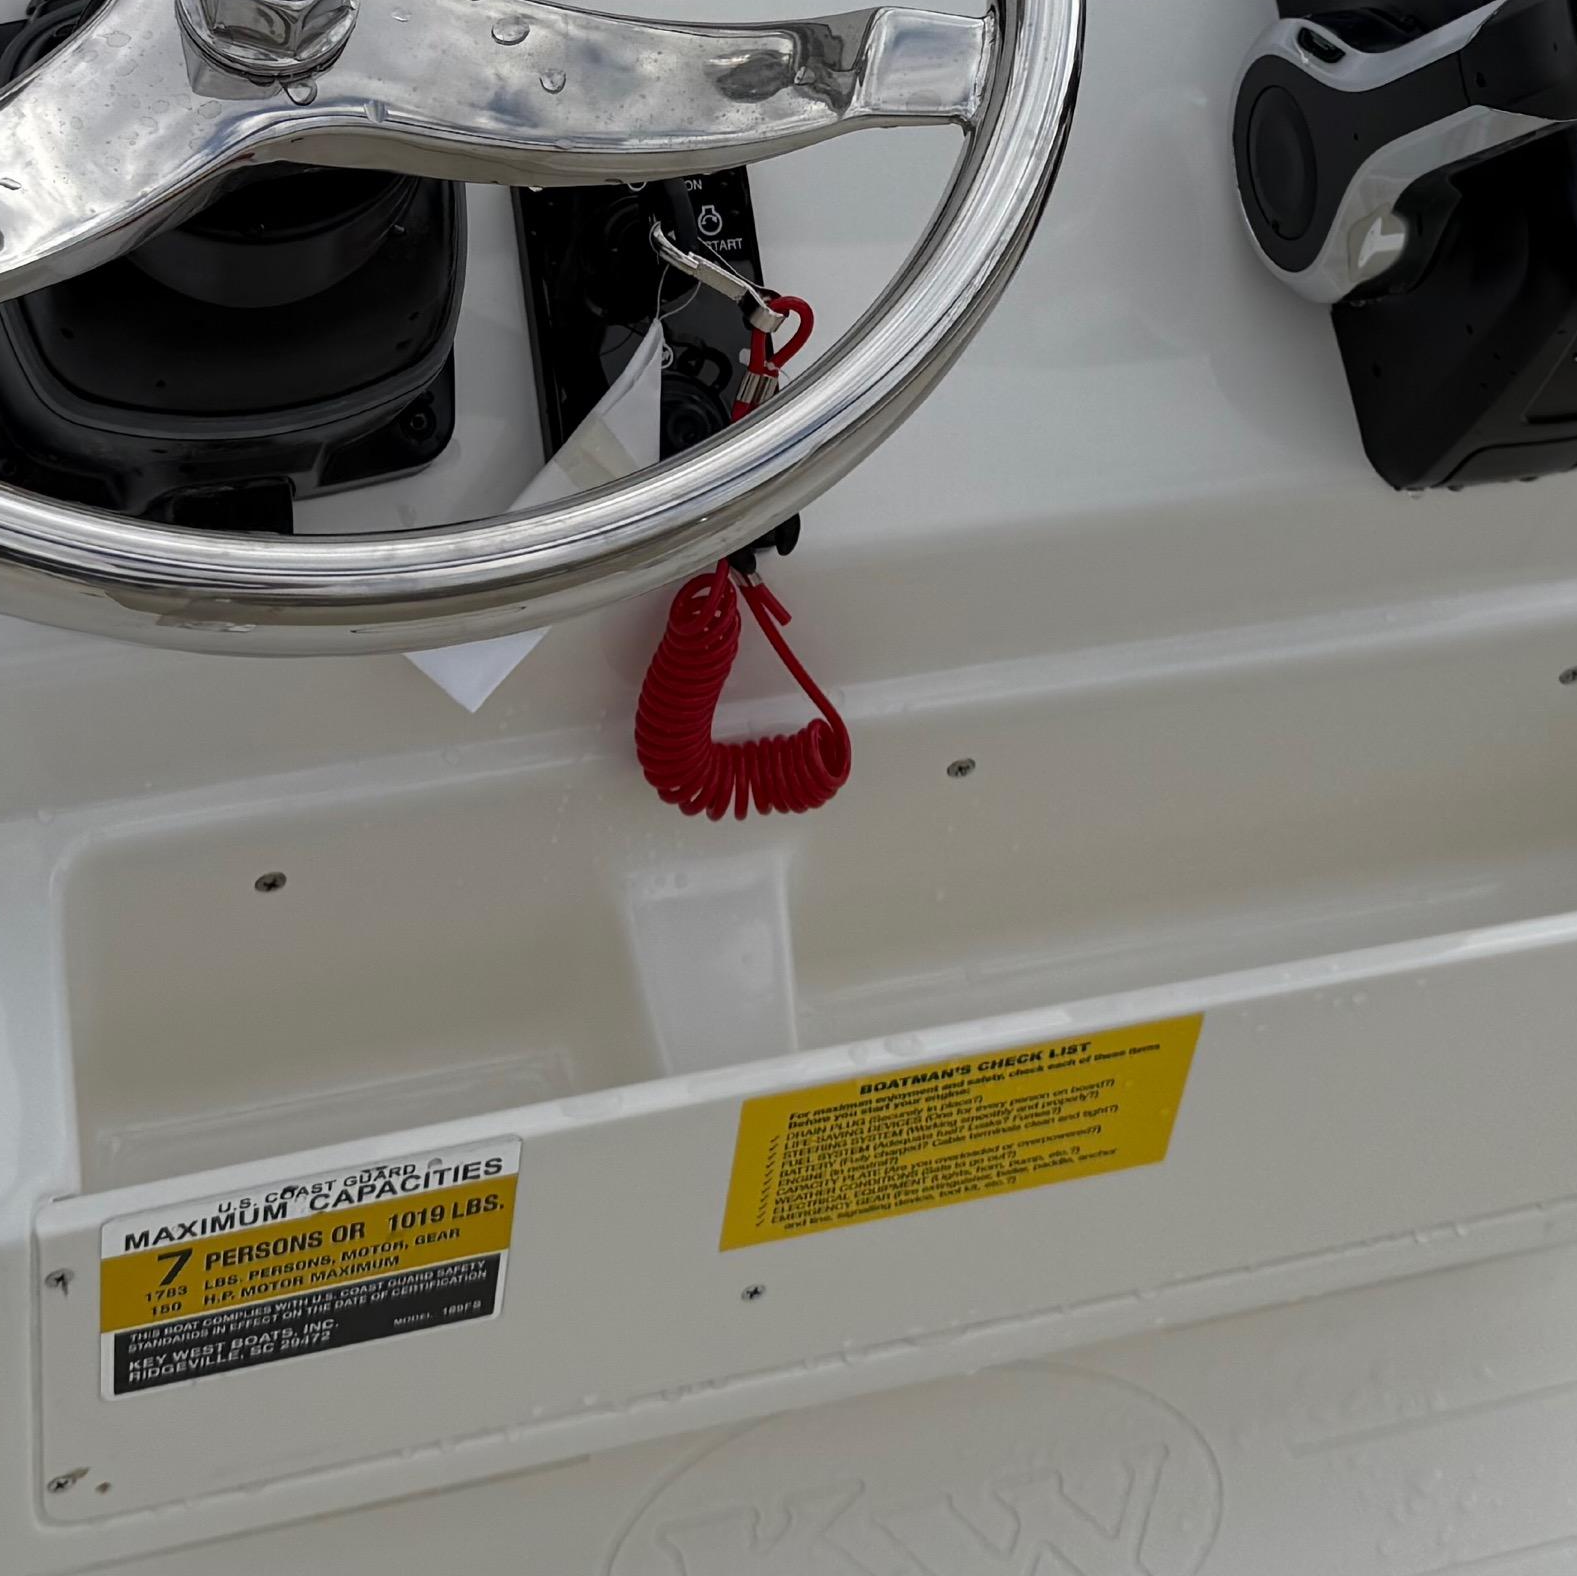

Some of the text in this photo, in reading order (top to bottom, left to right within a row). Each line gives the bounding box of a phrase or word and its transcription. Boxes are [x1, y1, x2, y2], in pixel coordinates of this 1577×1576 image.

[860, 1042, 1092, 1094] BOATMAN'S CHECK LIST
[124, 1156, 504, 1252] MAXIMUM CAPACITIES
[218, 1162, 416, 1214] U.S. COAST GUARD
[145, 1228, 460, 1303] 1783 LBS. PERSONS, MOTOR, GEAR
[157, 1191, 506, 1286] 7 PERSONS OR 1019 LBS.
[128, 1270, 486, 1353] STANDARDS IN EFFECT ON THE DATE OF CERTIFICATION
[130, 1329, 160, 1342] THIS
[164, 1321, 197, 1335] BOAT
[202, 1305, 271, 1327] COMPLIES
[275, 1297, 308, 1311] WITH
[340, 1281, 384, 1298] COAST
[388, 1271, 433, 1287] GUARD
[436, 1260, 485, 1277] SAFETY
[152, 1255, 399, 1316] 150 H.P. MOTOR MAXIMUM
[128, 1330, 331, 1383] RIDGEVILLE, SC 29472
[129, 1354, 167, 1371] KEY
[173, 1342, 225, 1362] WEST
[303, 1318, 339, 1335] INC.
